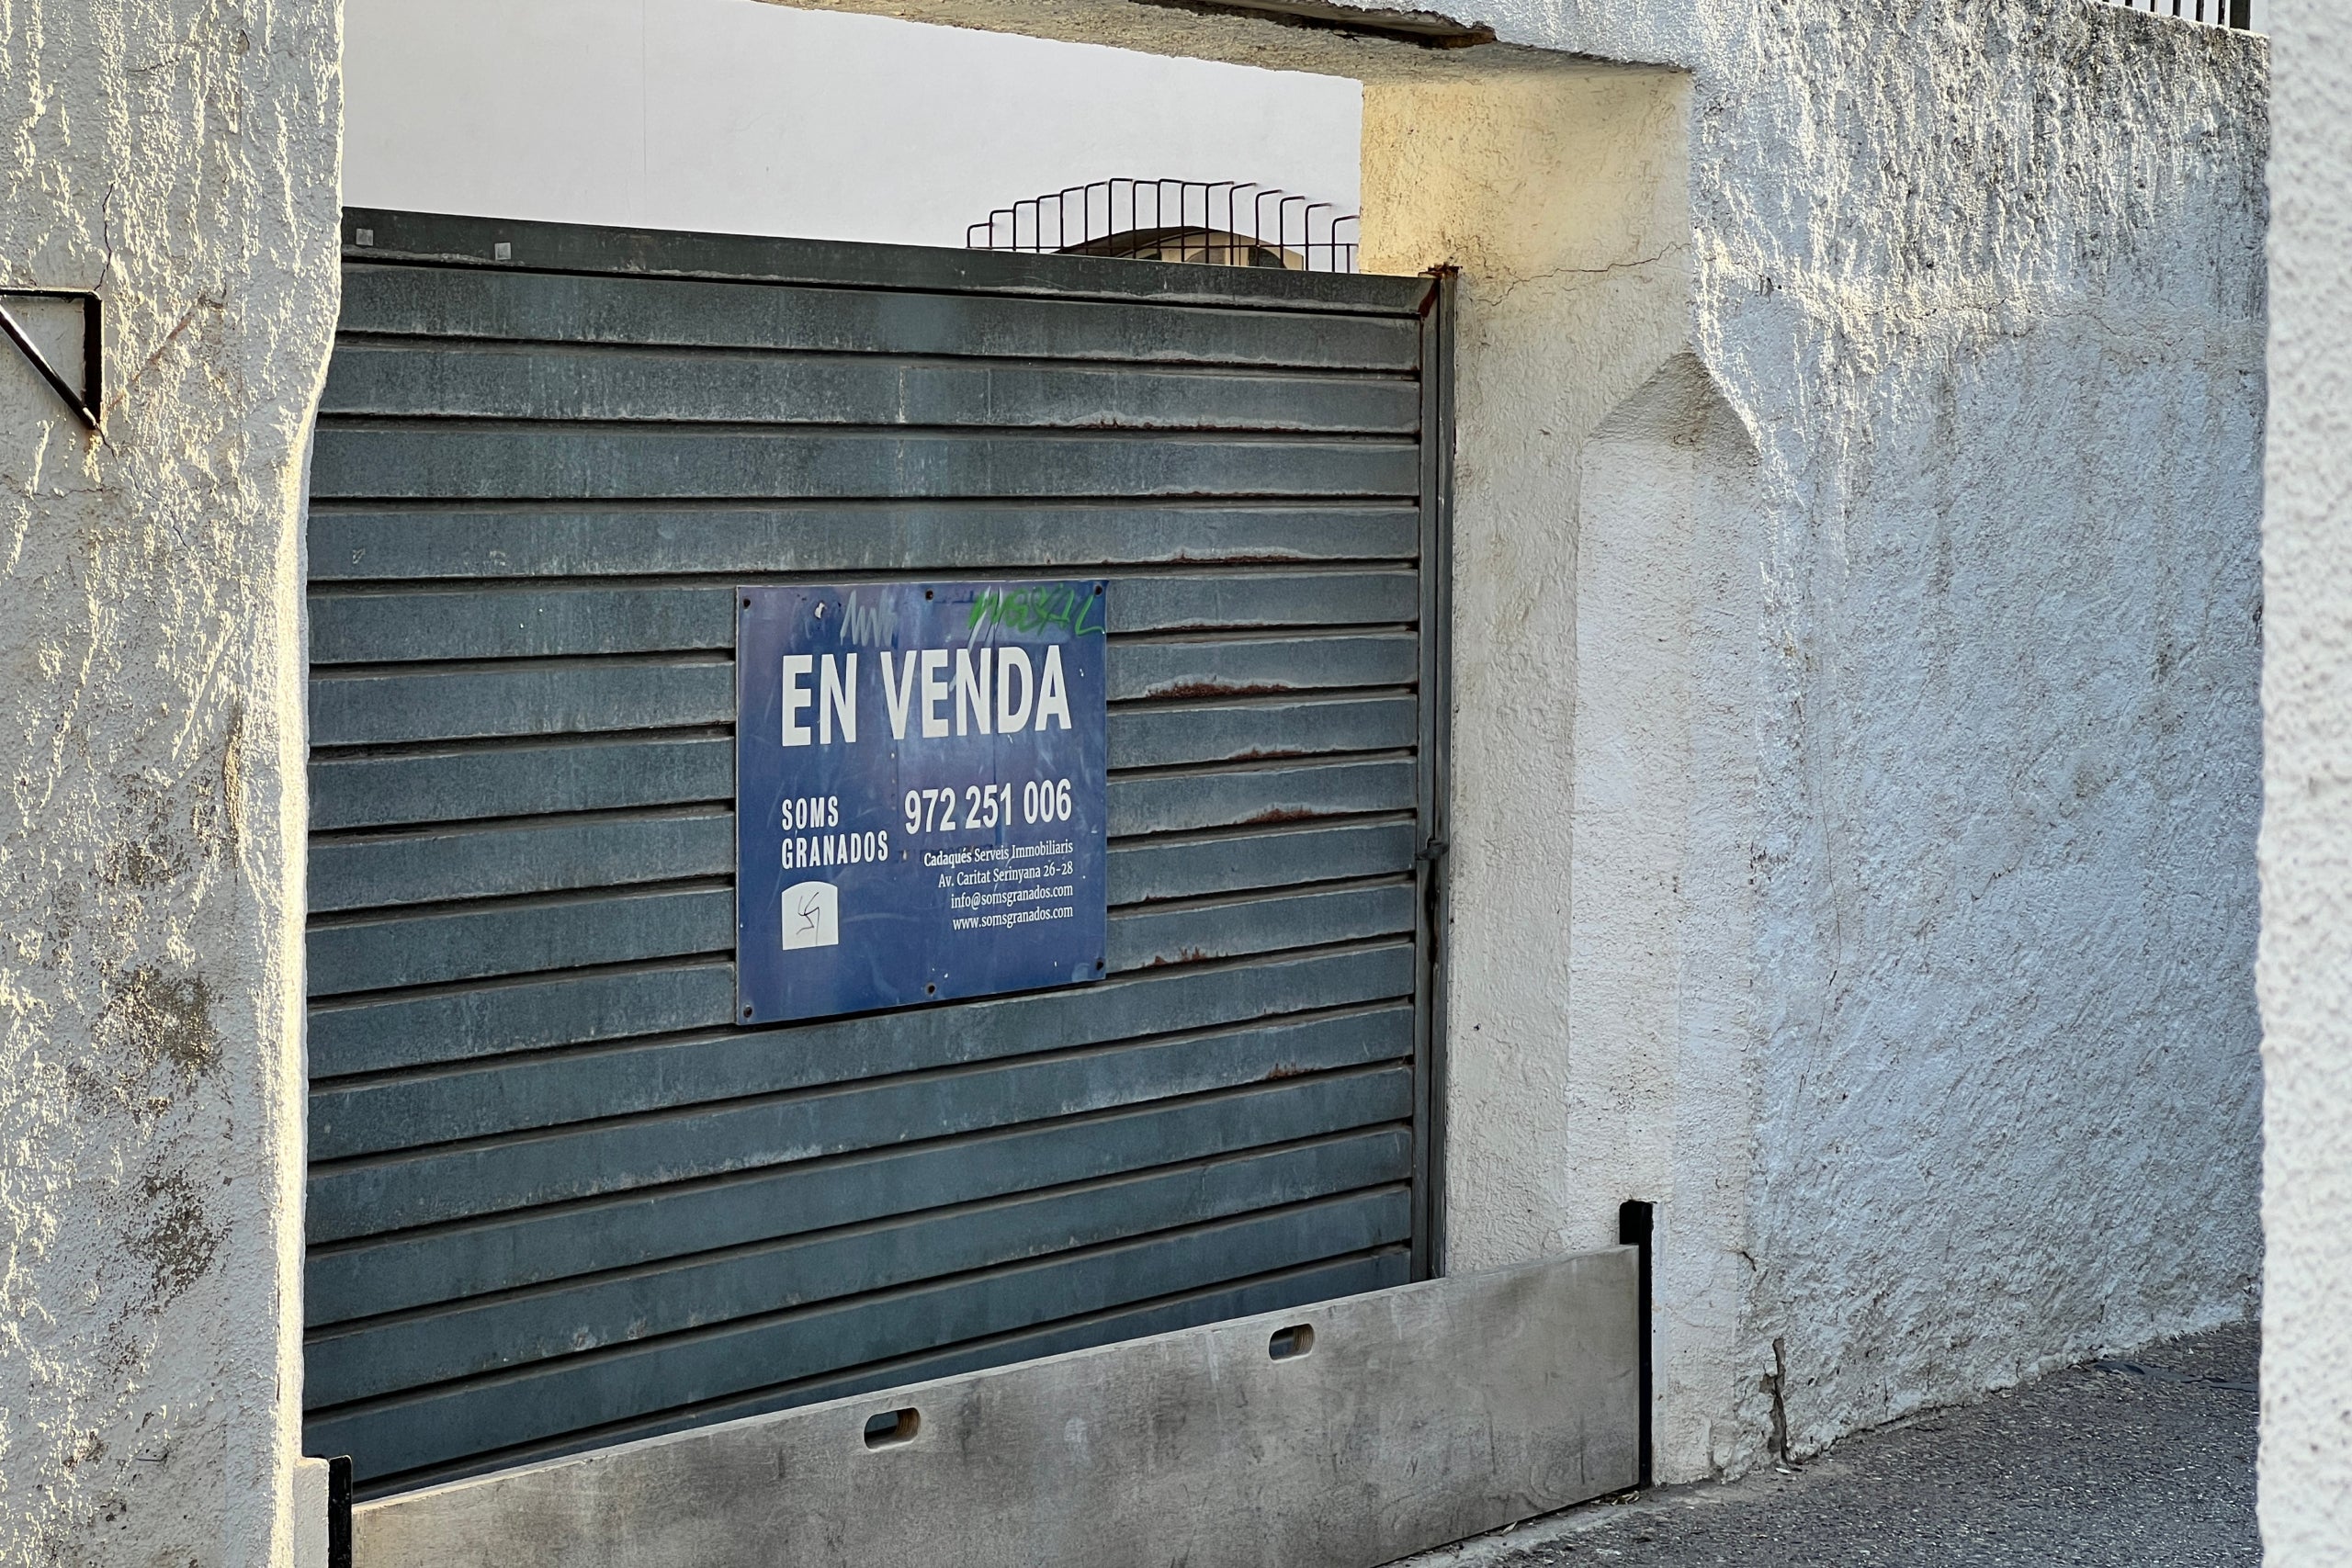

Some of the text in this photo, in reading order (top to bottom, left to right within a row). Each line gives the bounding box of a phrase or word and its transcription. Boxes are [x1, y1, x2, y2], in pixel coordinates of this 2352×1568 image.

[782, 645, 1072, 747] EN VENDA
[781, 795, 839, 830] SOMS
[904, 778, 1072, 835] 972 251 006
[781, 829, 888, 870] GRANADOS
[923, 839, 1073, 869] Cadaqués Serveis Immobiliaris
[938, 861, 1073, 888] Av. Caritat Serinyana 26-28
[951, 884, 1073, 910] info@somsgranados.com
[953, 906, 1073, 931] www.somsgranados.com
